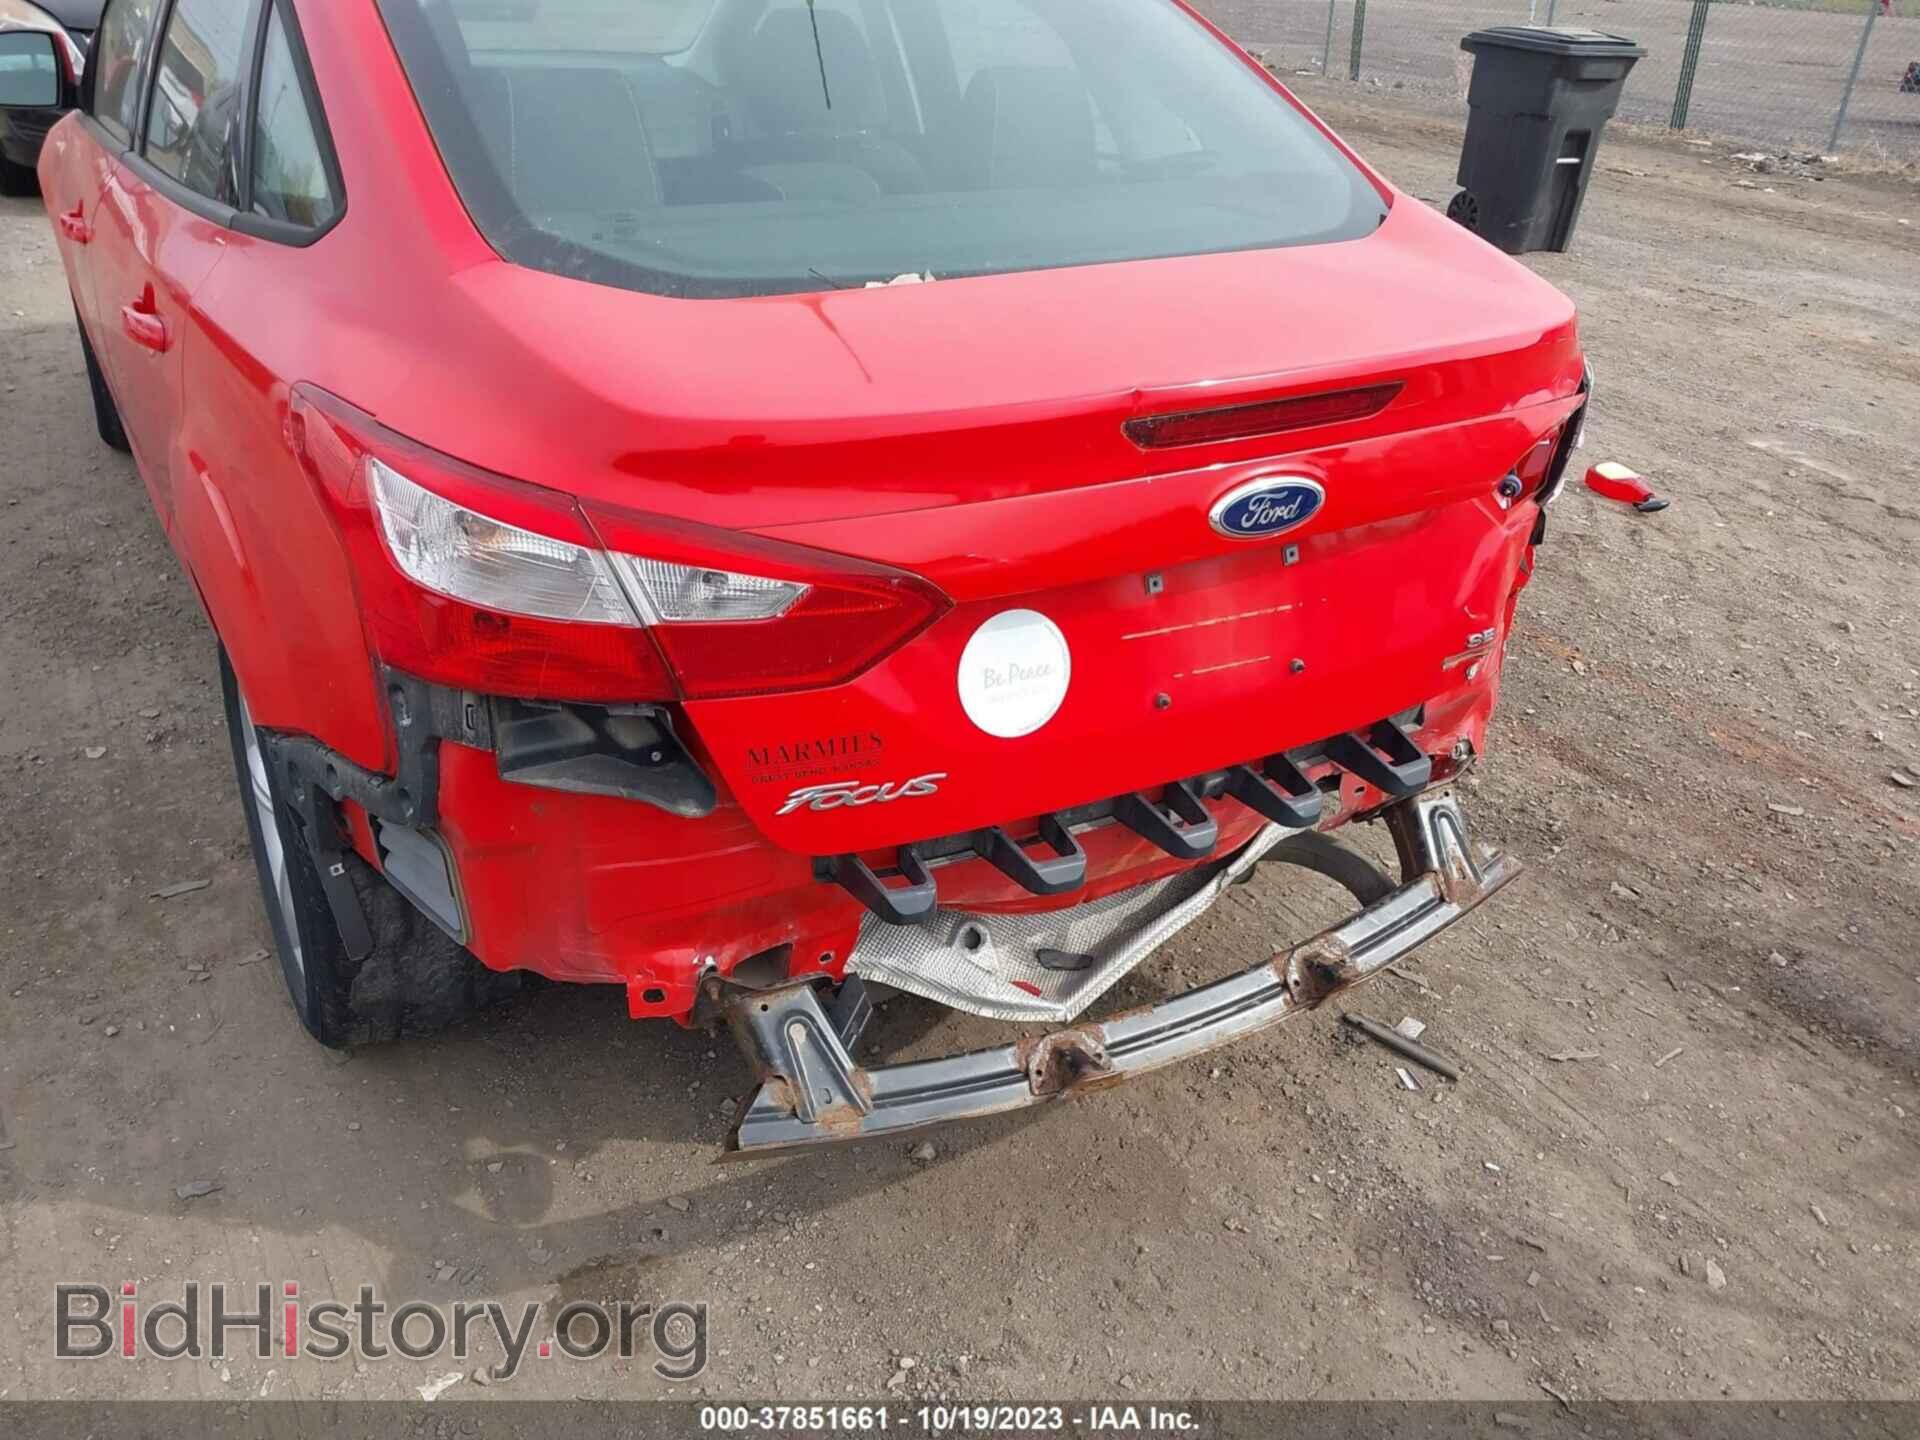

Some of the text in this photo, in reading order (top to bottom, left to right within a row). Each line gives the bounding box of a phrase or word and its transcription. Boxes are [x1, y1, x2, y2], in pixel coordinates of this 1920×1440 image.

[1241, 490, 1302, 528] Ford
[1466, 627, 1496, 648] SE
[1008, 662, 1051, 685] Peace
